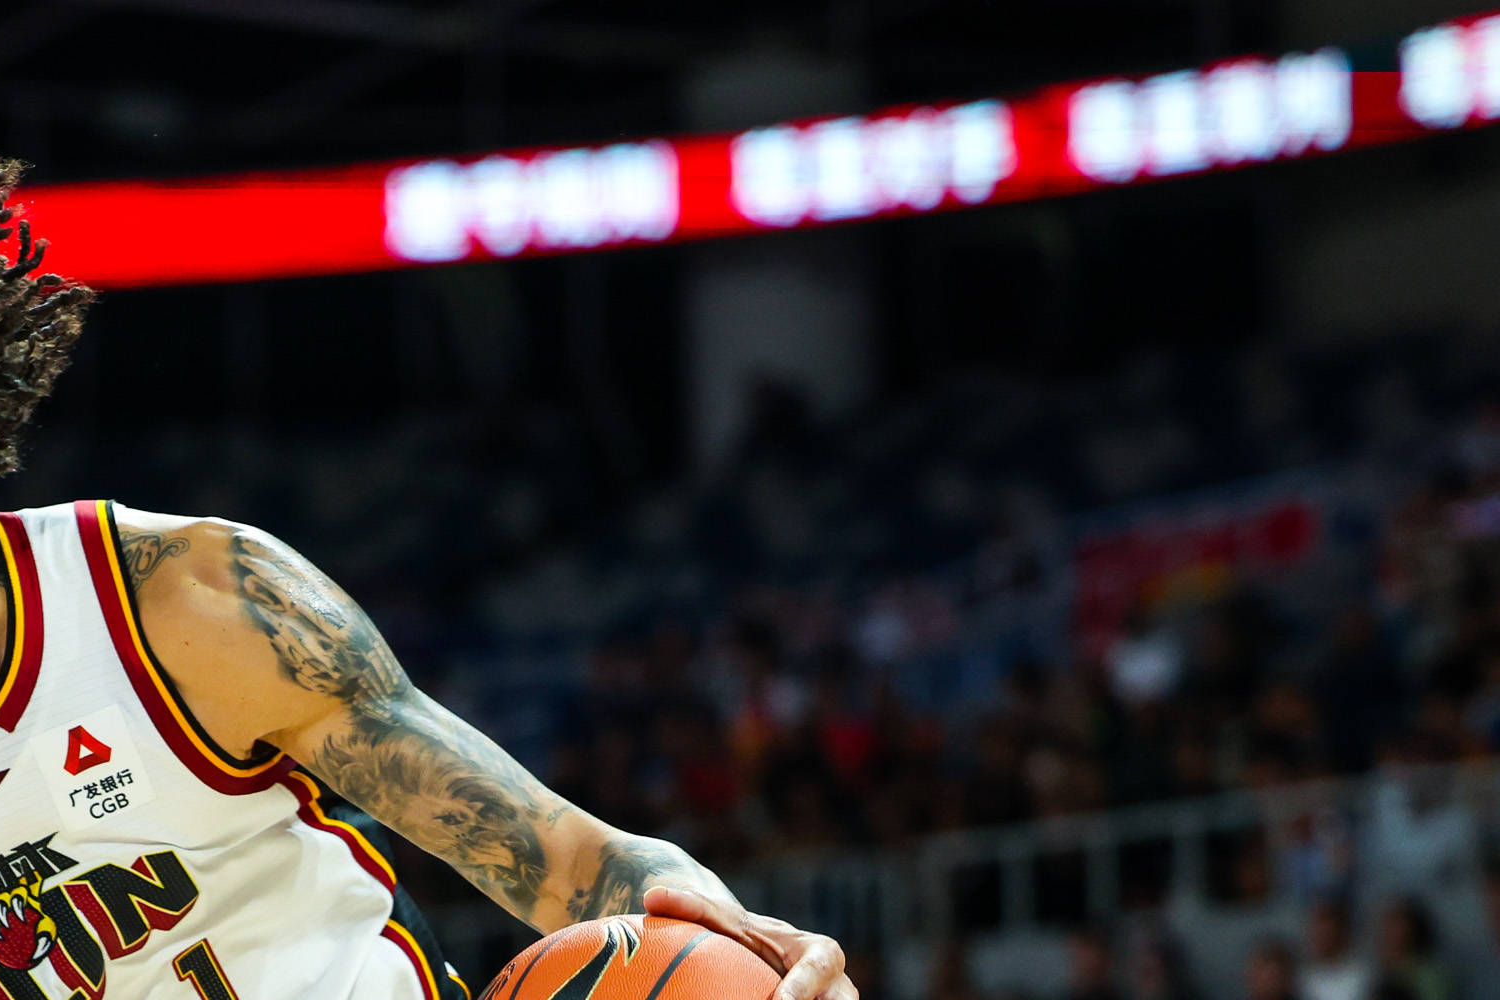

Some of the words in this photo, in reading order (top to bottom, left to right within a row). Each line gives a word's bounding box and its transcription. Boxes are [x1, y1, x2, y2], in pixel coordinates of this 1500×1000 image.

[69, 768, 134, 807] 广发银行
[89, 793, 130, 819] CGB
